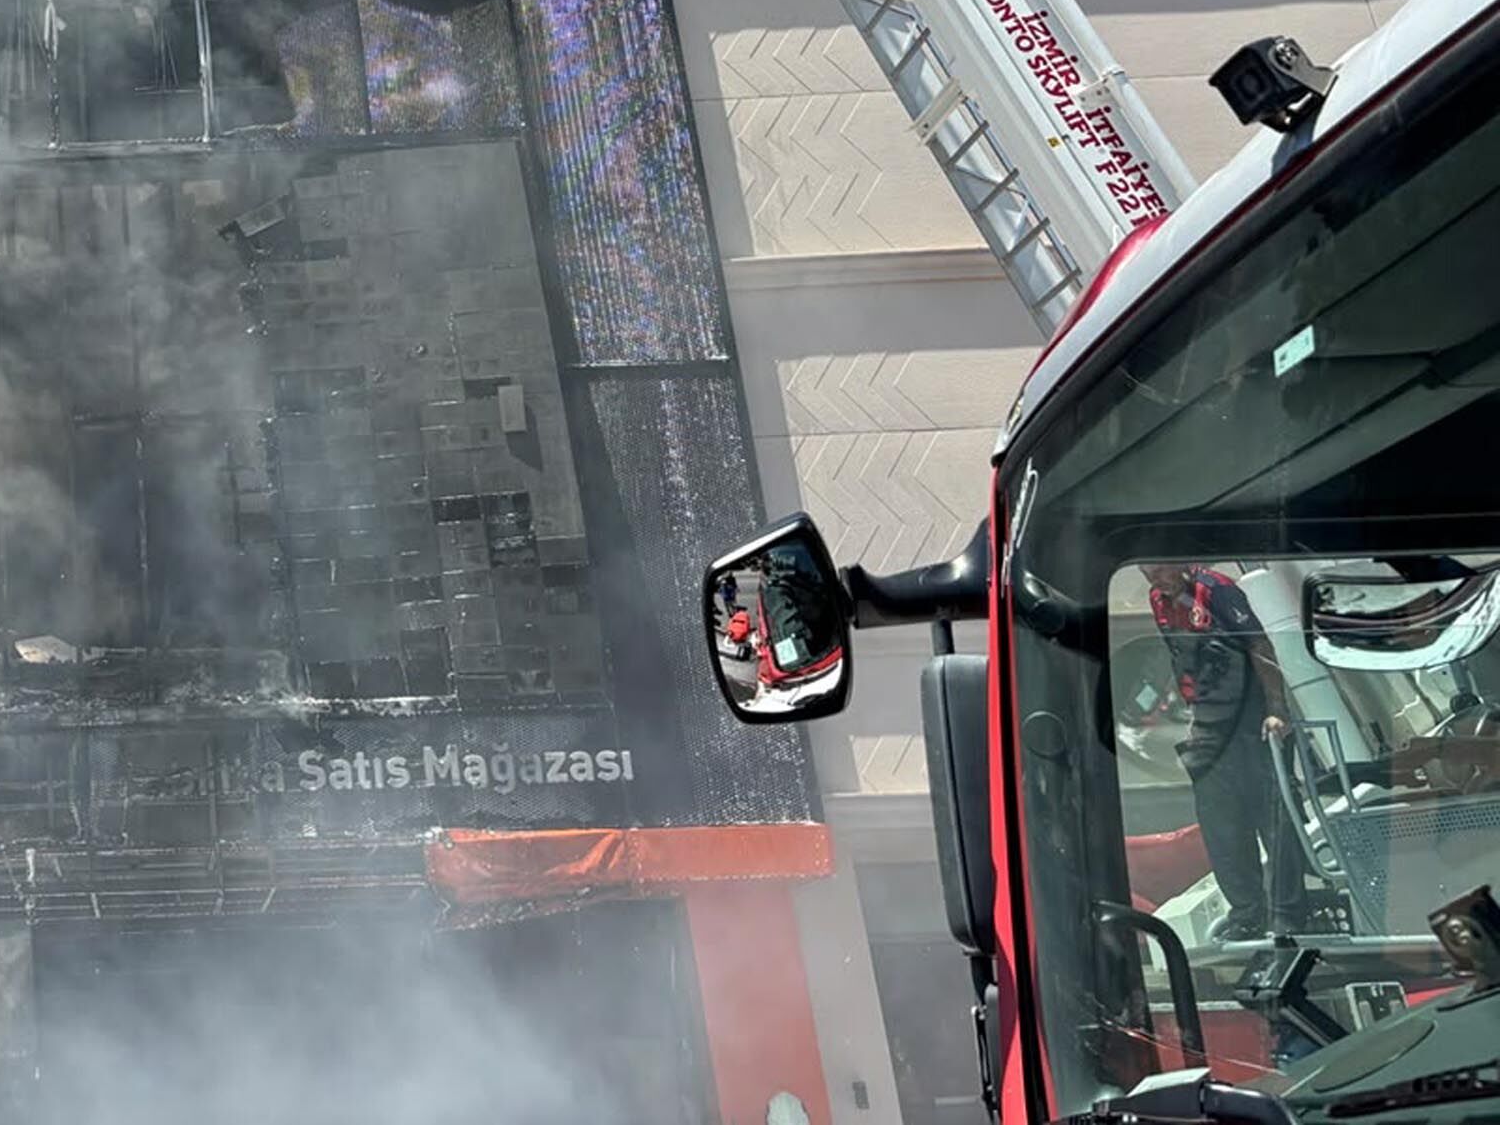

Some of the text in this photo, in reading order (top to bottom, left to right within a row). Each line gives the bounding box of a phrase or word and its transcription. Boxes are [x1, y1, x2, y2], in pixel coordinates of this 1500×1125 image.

[1022, 10, 1081, 88] İZMİR
[1027, 51, 1100, 149] SKYLIFT
[421, 743, 635, 795] Mağazası
